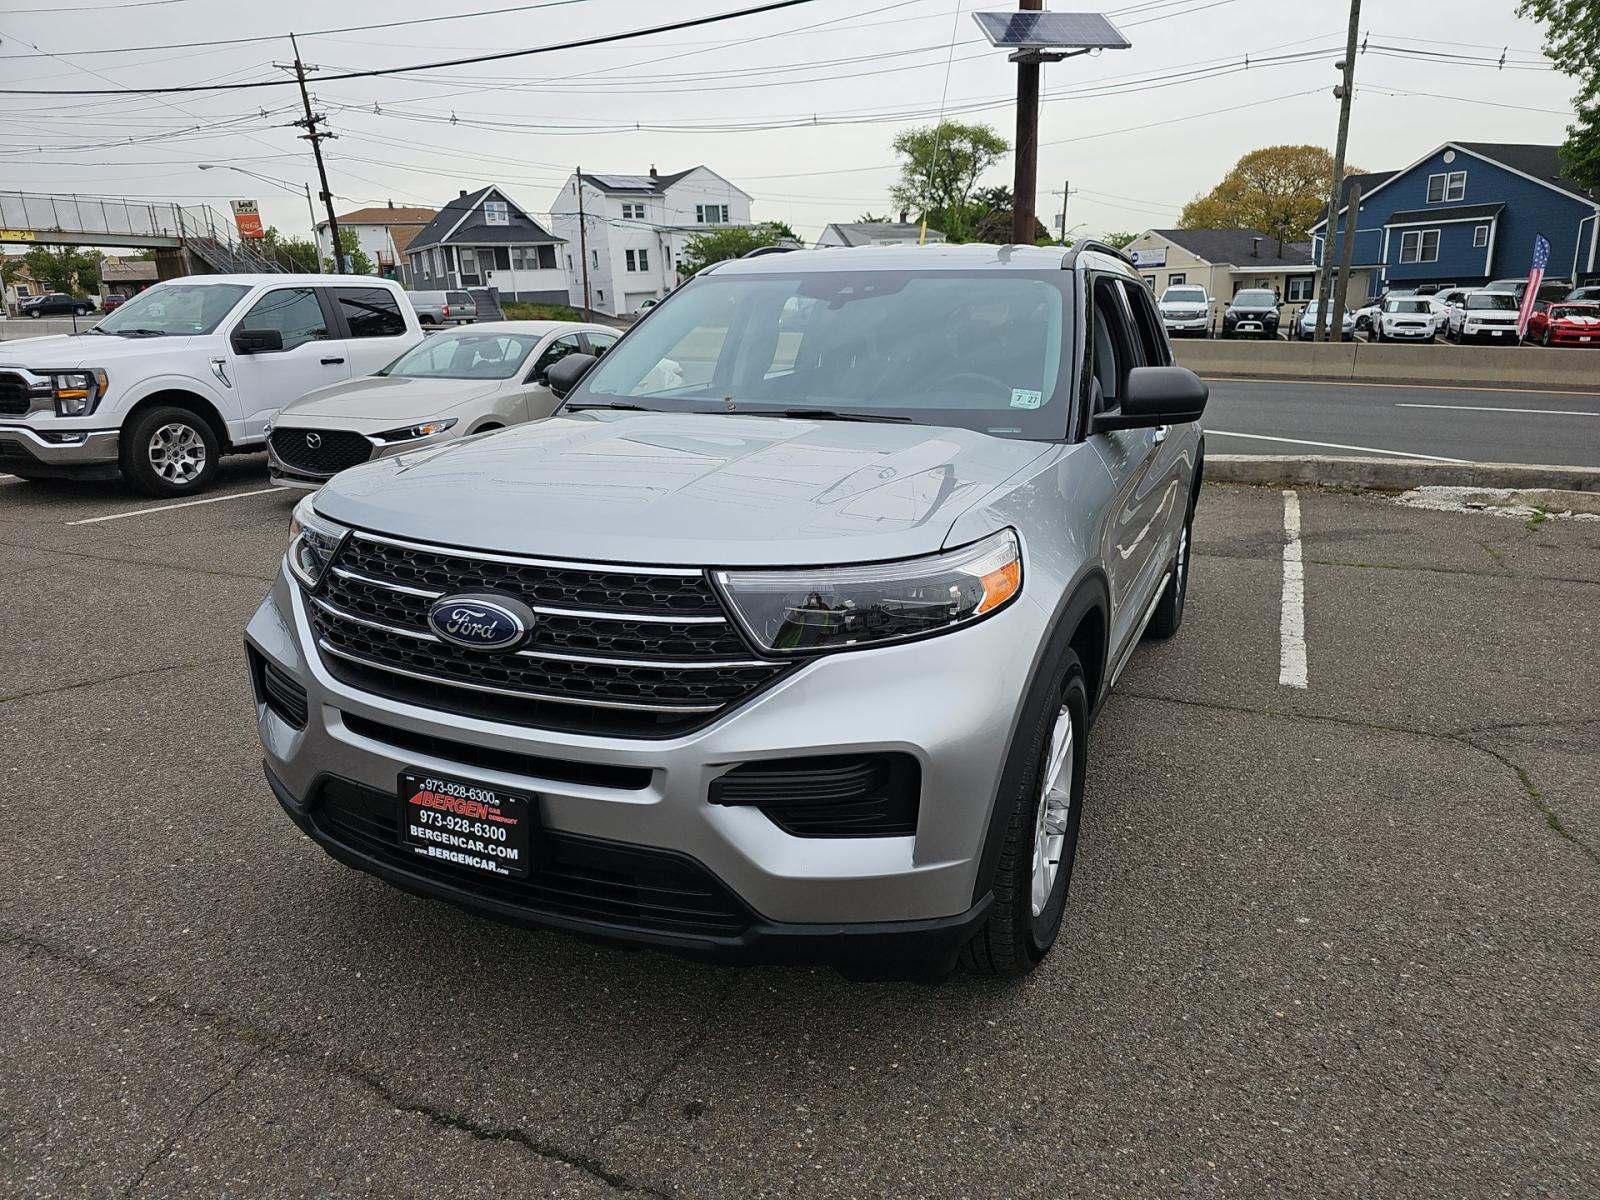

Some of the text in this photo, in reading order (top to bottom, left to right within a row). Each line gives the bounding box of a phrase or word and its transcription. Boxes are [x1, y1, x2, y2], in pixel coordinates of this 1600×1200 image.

[1027, 395, 1038, 404] 27
[446, 608, 498, 639] Ford
[421, 791, 489, 820] BERGEN
[425, 779, 495, 804] 973-928-6300
[419, 809, 507, 841] 973-928-6300
[409, 824, 519, 860] BERGENCAR.COM
